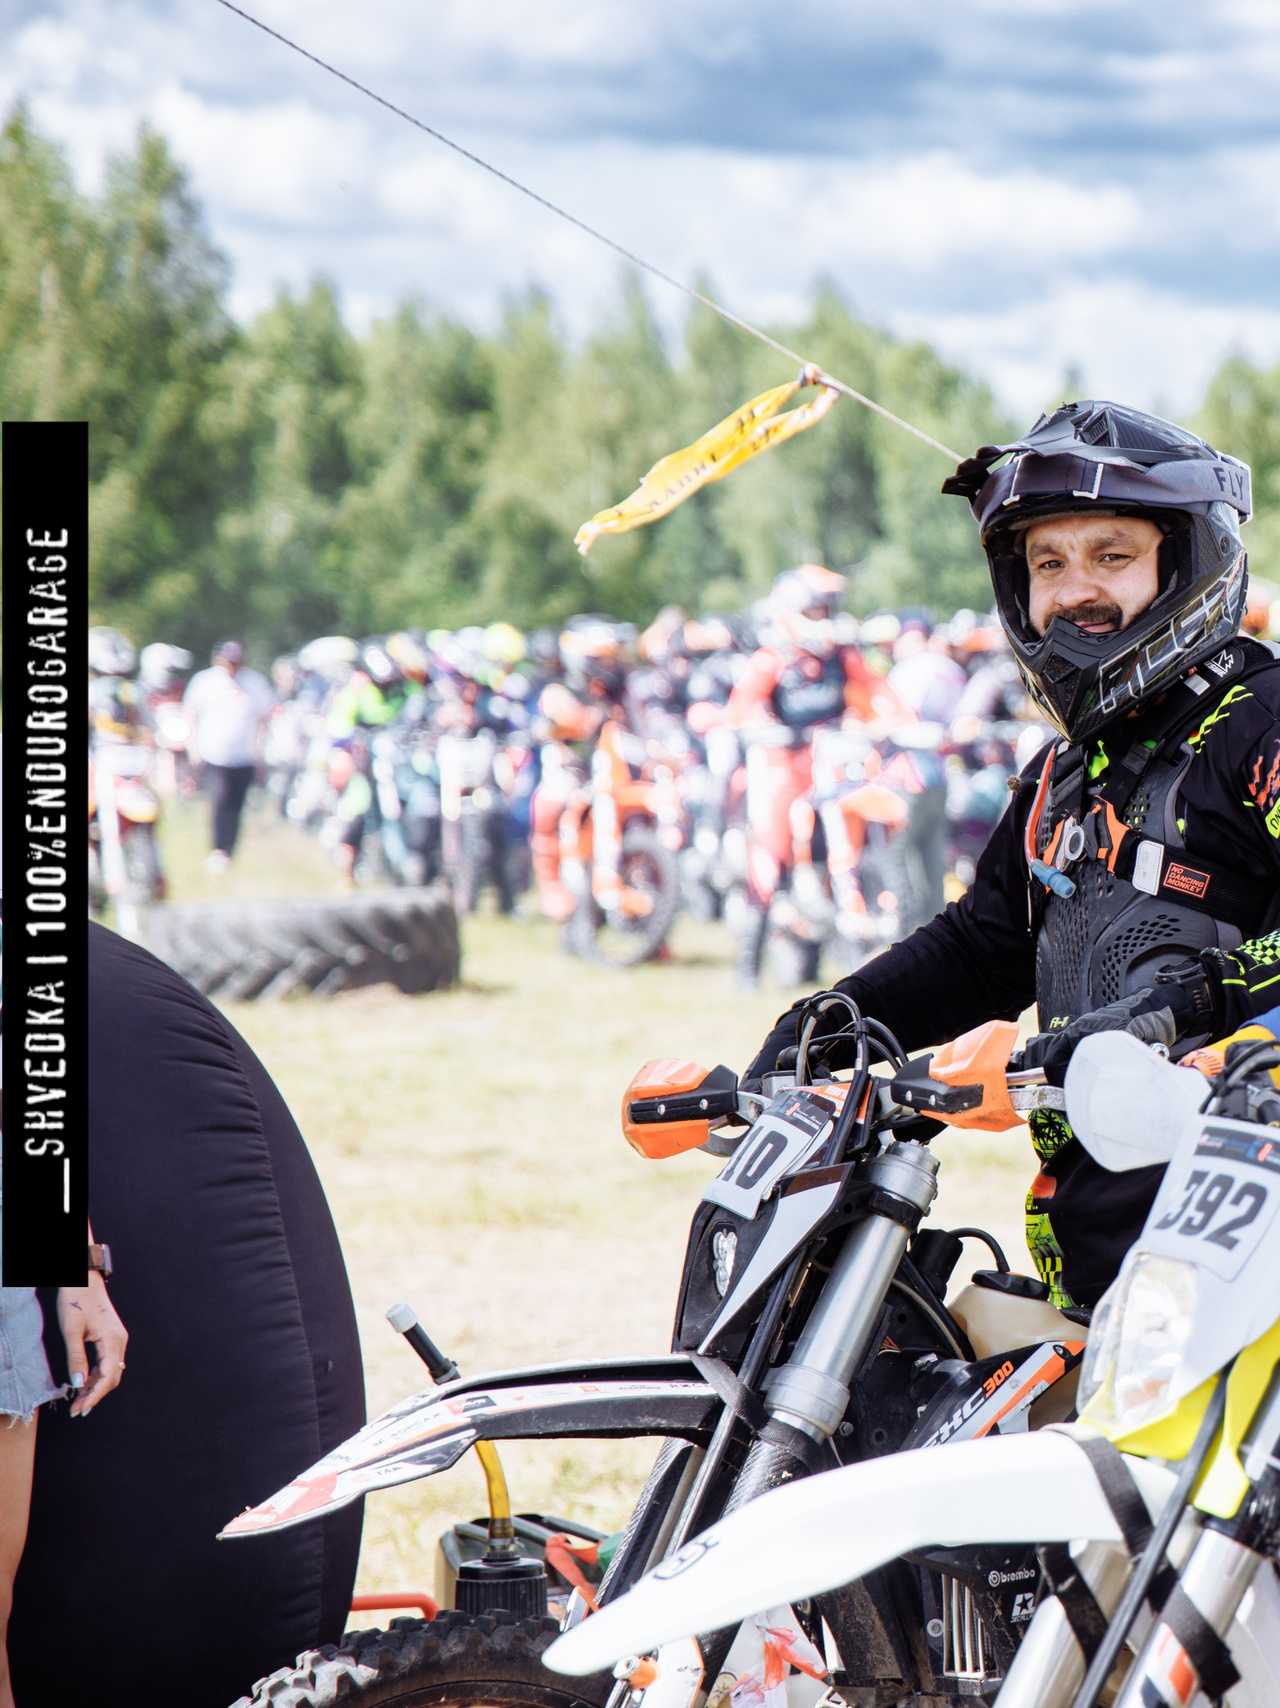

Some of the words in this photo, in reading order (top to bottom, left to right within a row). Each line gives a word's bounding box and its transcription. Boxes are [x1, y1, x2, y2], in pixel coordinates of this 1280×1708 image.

[1213, 467, 1244, 501] FLY
[1171, 866, 1184, 875] NO
[1166, 879, 1202, 894] MONKEY
[1168, 872, 1205, 888] DANCING
[1153, 1169, 1268, 1251] 392
[983, 1360, 1014, 1399] 300
[1000, 1568, 1036, 1583] brembo
